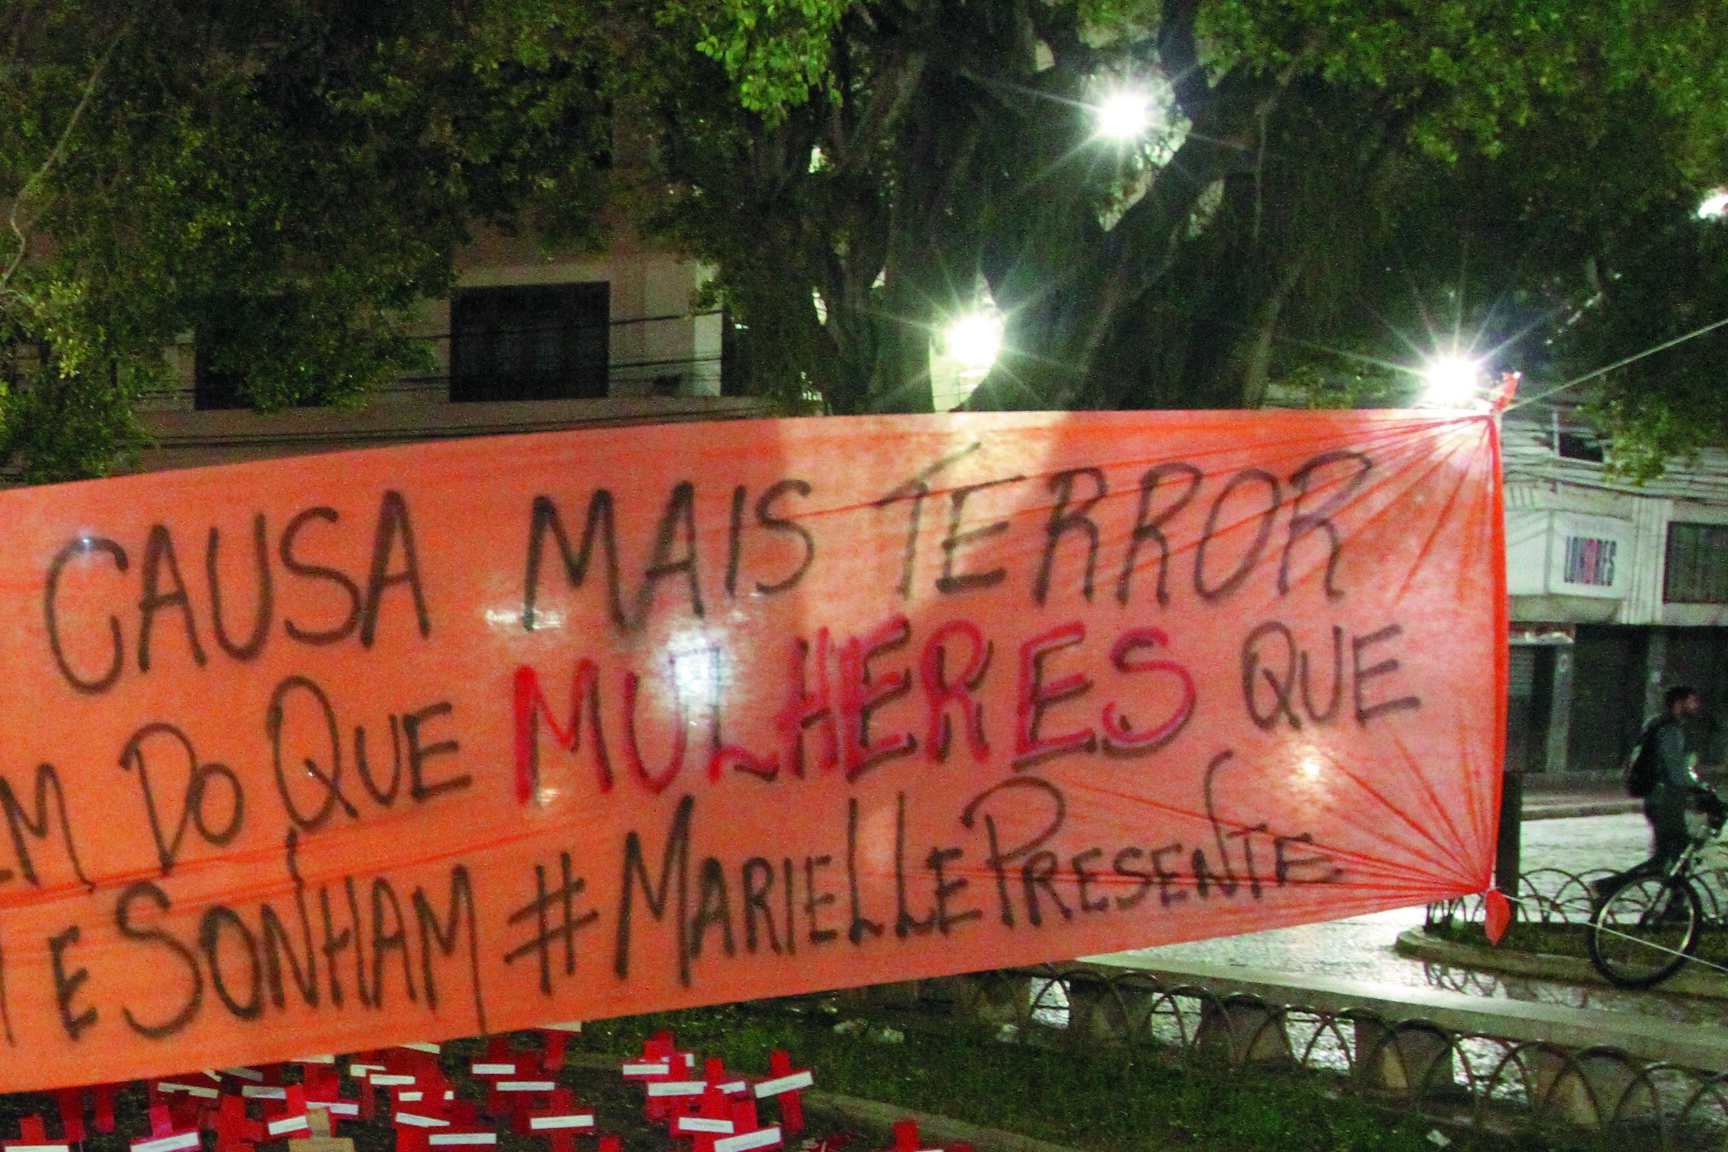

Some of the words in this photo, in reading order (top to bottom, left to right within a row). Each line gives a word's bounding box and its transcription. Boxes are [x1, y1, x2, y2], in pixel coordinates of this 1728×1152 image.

[44, 489, 430, 694] CAUSA
[522, 478, 814, 630] MAIS
[875, 443, 1374, 606] TERROR
[265, 675, 472, 832] QUE
[512, 615, 1200, 805] MULHERES
[1240, 620, 1421, 731] QUE
[47, 925, 98, 1041] E
[115, 828, 487, 1040] SONHAM
